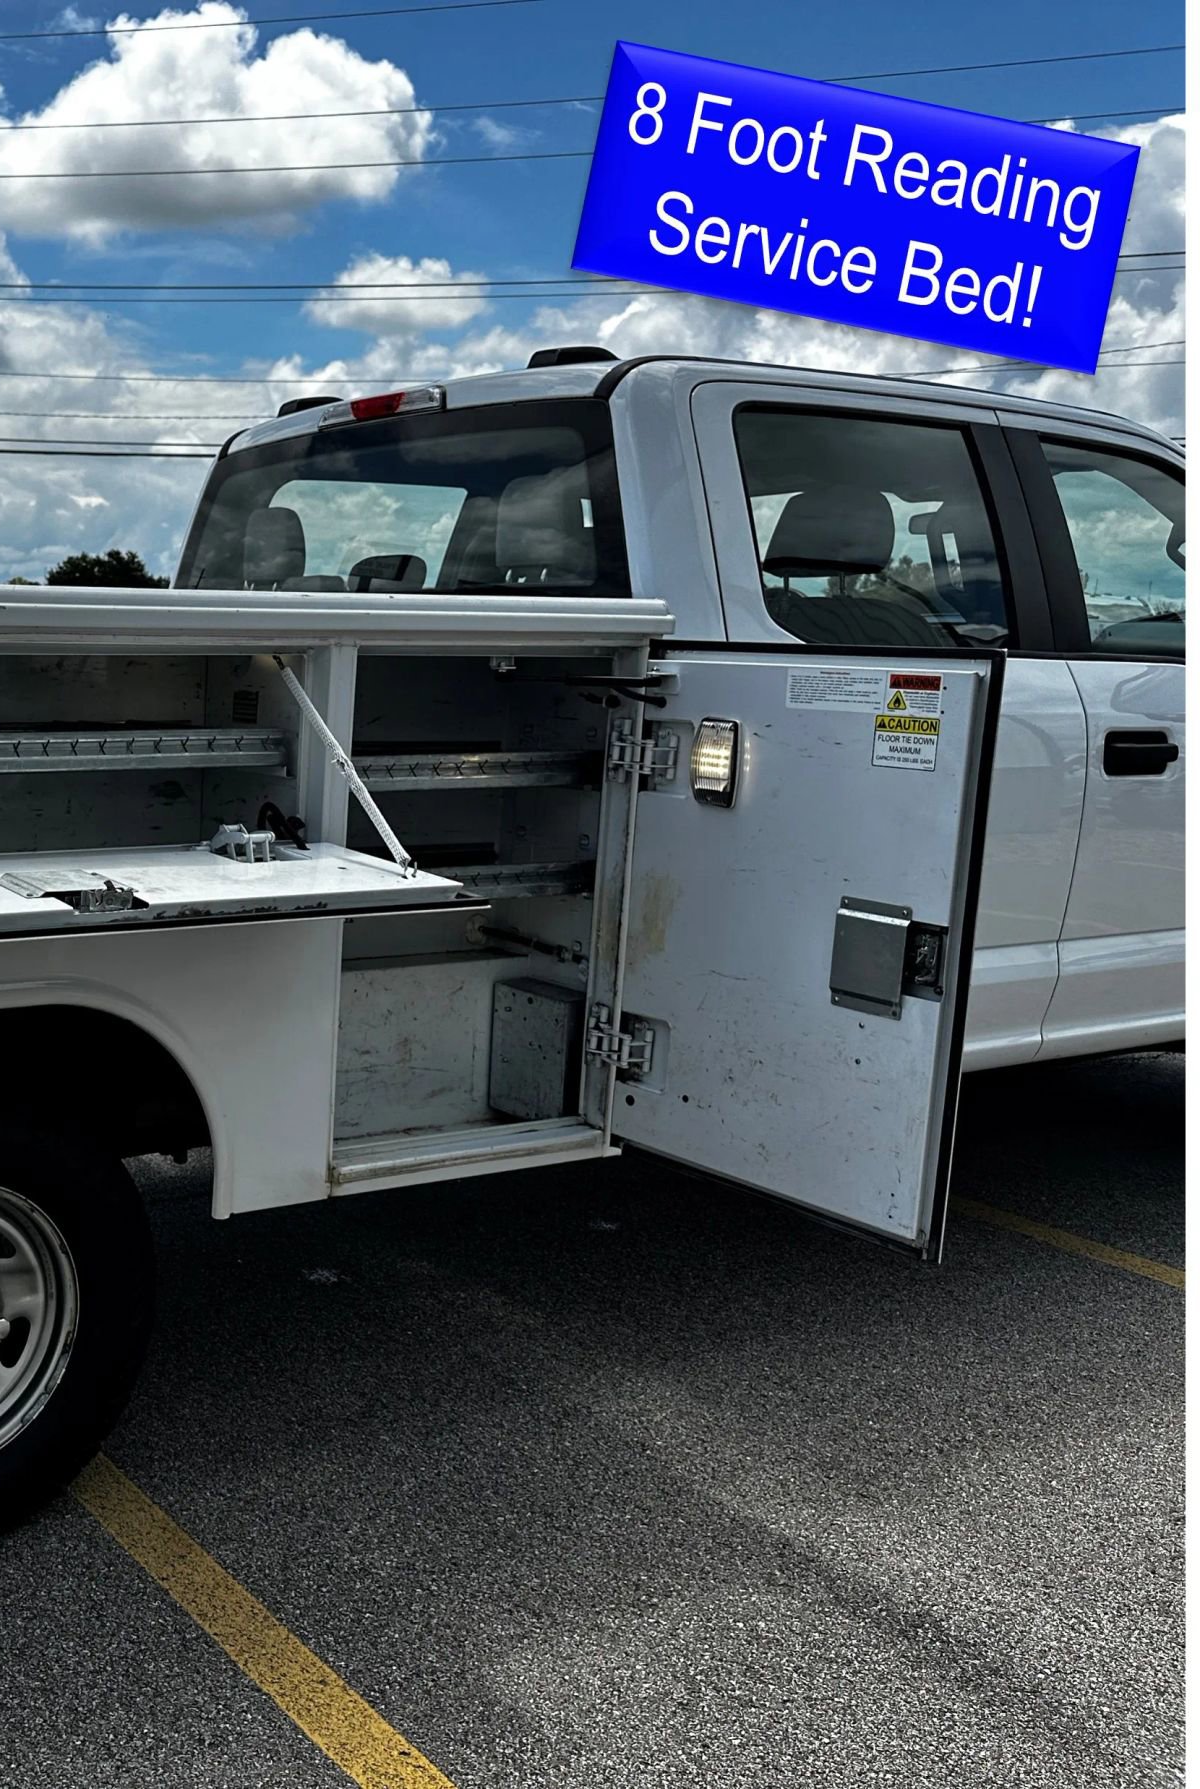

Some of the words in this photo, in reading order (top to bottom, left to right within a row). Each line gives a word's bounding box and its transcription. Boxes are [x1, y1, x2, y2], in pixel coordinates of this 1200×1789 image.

[903, 677, 940, 690] WARNING
[887, 718, 938, 732] CAUTION
[877, 734, 900, 743] FLOOR
[902, 736, 912, 744] TIE
[913, 737, 935, 745] DOWN
[888, 745, 921, 755] MAXIMUM
